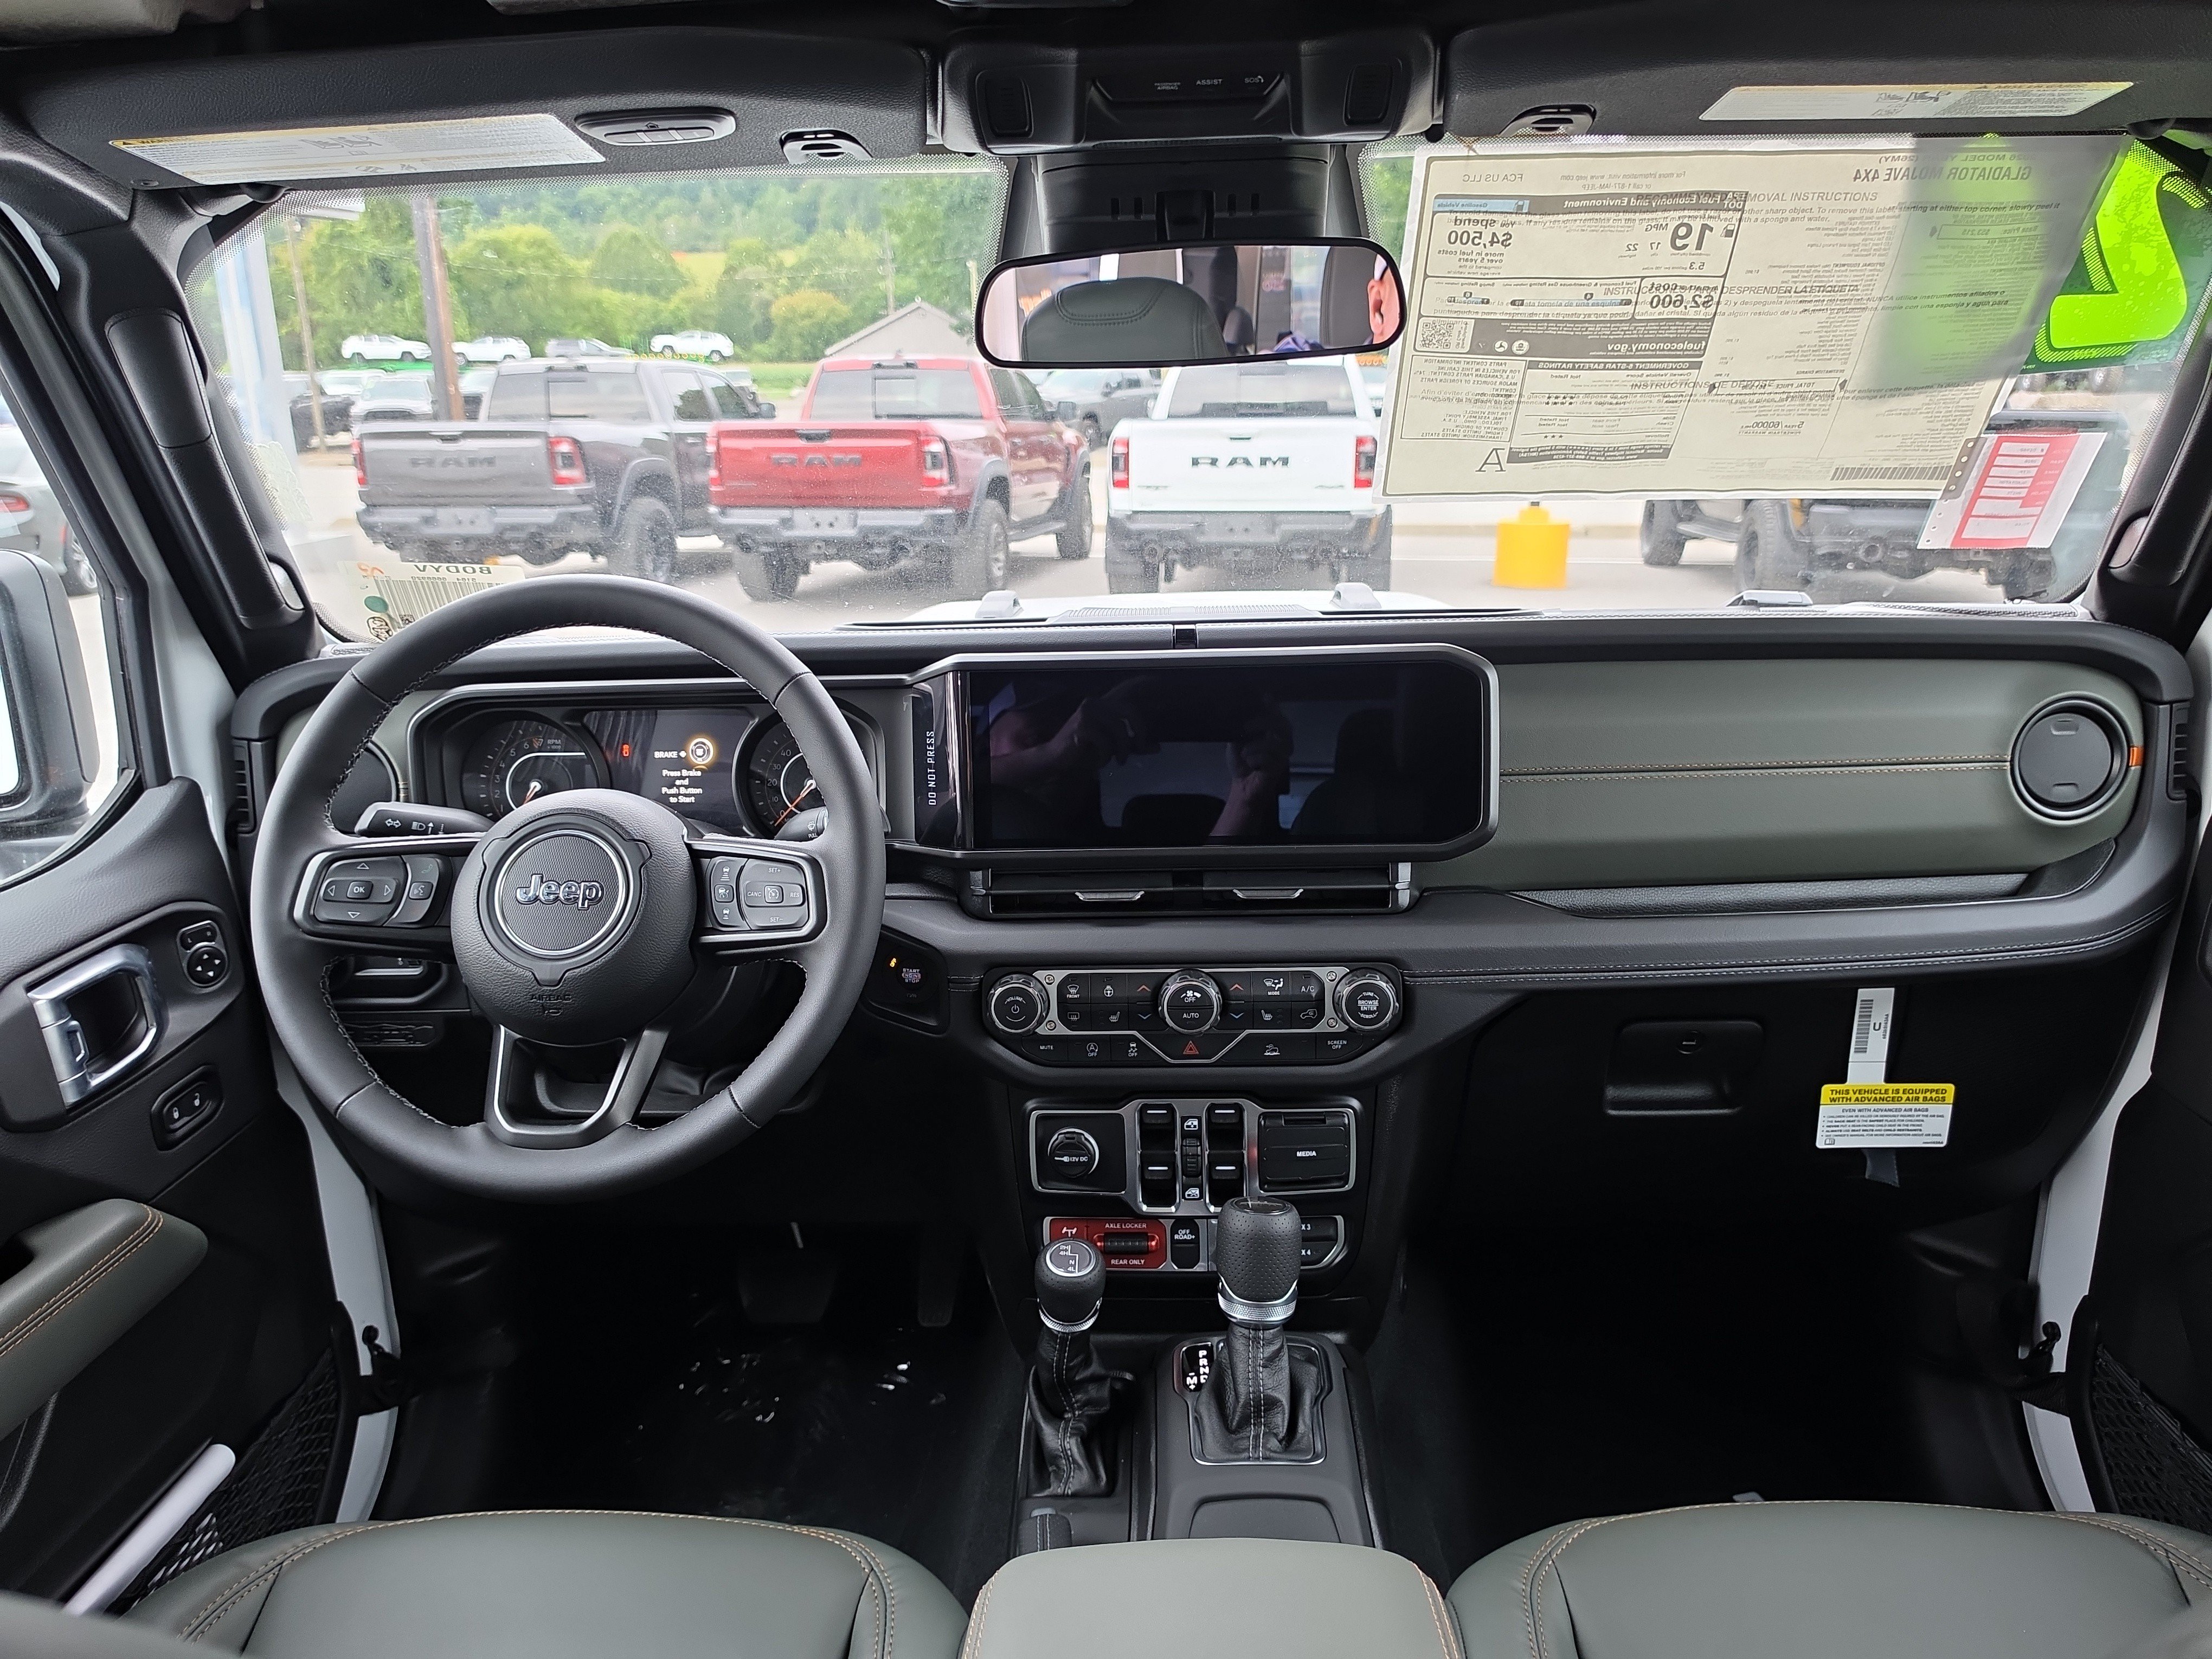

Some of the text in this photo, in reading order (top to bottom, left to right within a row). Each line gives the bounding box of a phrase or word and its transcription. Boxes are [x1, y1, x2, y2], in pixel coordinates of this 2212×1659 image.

[1790, 191, 1877, 202] INSTRUCTIONS
[1765, 207, 1786, 216] sharp
[1789, 207, 1815, 215] object.
[2009, 204, 2034, 212] slowly
[2035, 203, 2053, 211] peel
[1721, 286, 1792, 294] DESPRENDER
[1793, 285, 1808, 294] LA
[1809, 284, 1859, 293] ETIQUETA
[410, 456, 497, 468] RAM
[771, 454, 862, 467] RAM
[1191, 456, 1290, 467] RAM
[510, 748, 516, 756] 5
[926, 731, 936, 805] DO NOT PRESS
[494, 775, 500, 783] 3
[516, 873, 605, 910] Jeep
[530, 994, 573, 1003] AIRBAG
[1199, 1358, 1208, 1366] R
[1200, 1366, 1210, 1374] N
[1186, 1376, 1198, 1386] M
